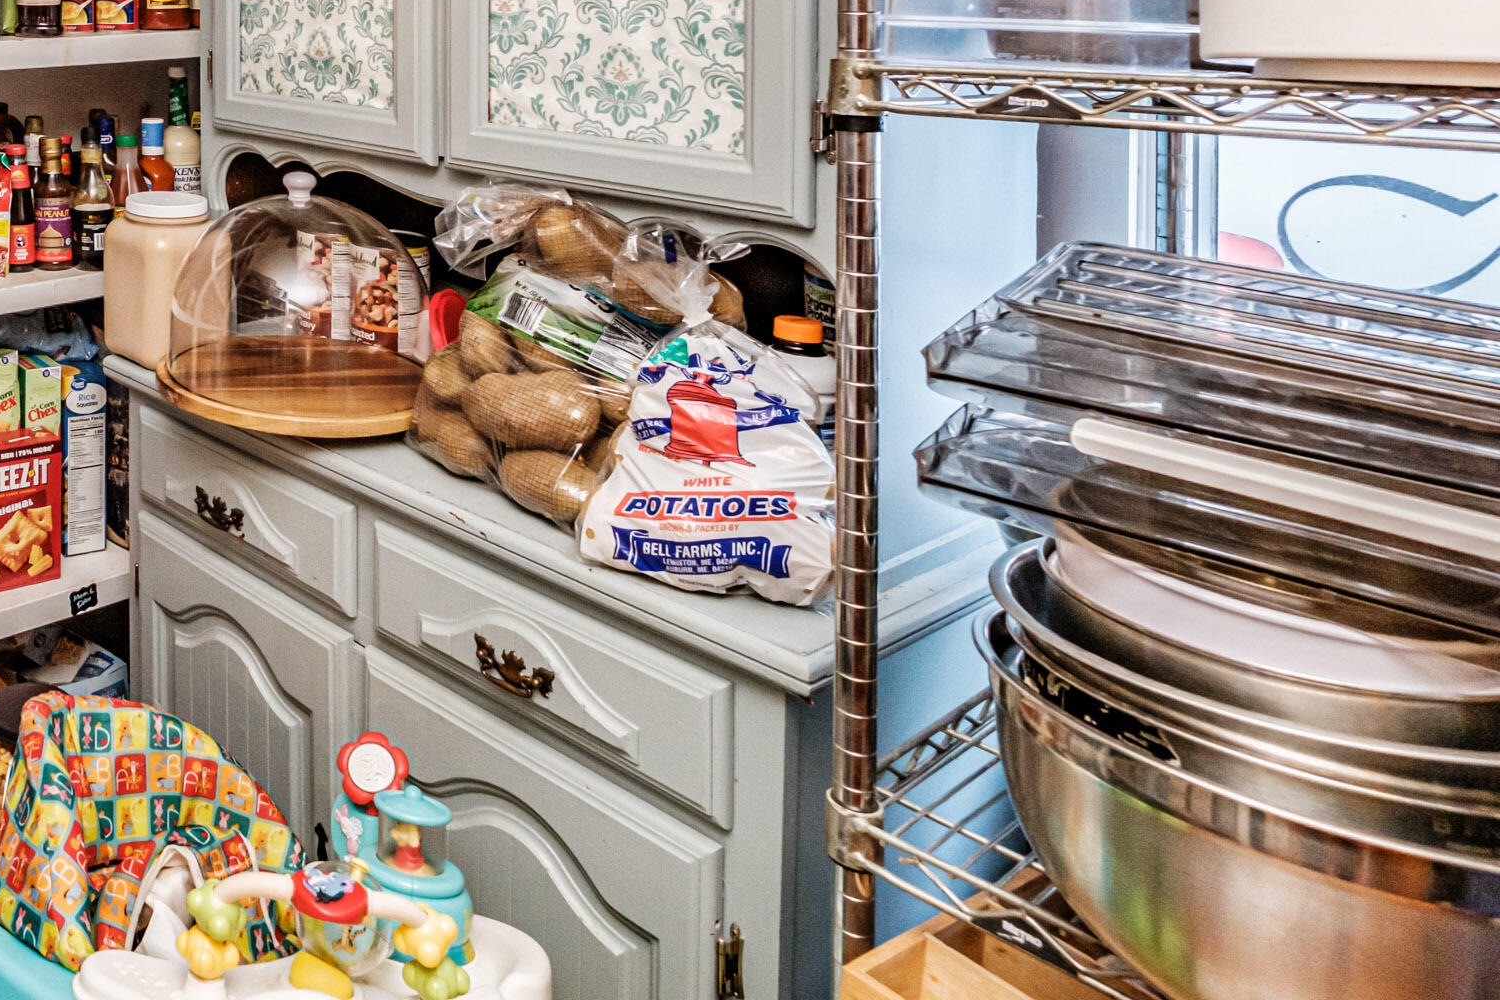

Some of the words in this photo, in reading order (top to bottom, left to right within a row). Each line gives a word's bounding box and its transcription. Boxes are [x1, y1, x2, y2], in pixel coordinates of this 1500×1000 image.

[43, 209, 70, 218] PEANUT
[78, 392, 96, 402] Rice
[39, 401, 55, 411] Corn
[28, 405, 58, 423] Chex
[683, 477, 733, 488] WHITE
[622, 495, 792, 518] POTATOES
[695, 524, 726, 532] PACKED
[729, 524, 740, 532] BY
[642, 541, 672, 557] BELL
[675, 544, 728, 559] FARMS,
[731, 541, 762, 556] INC.
